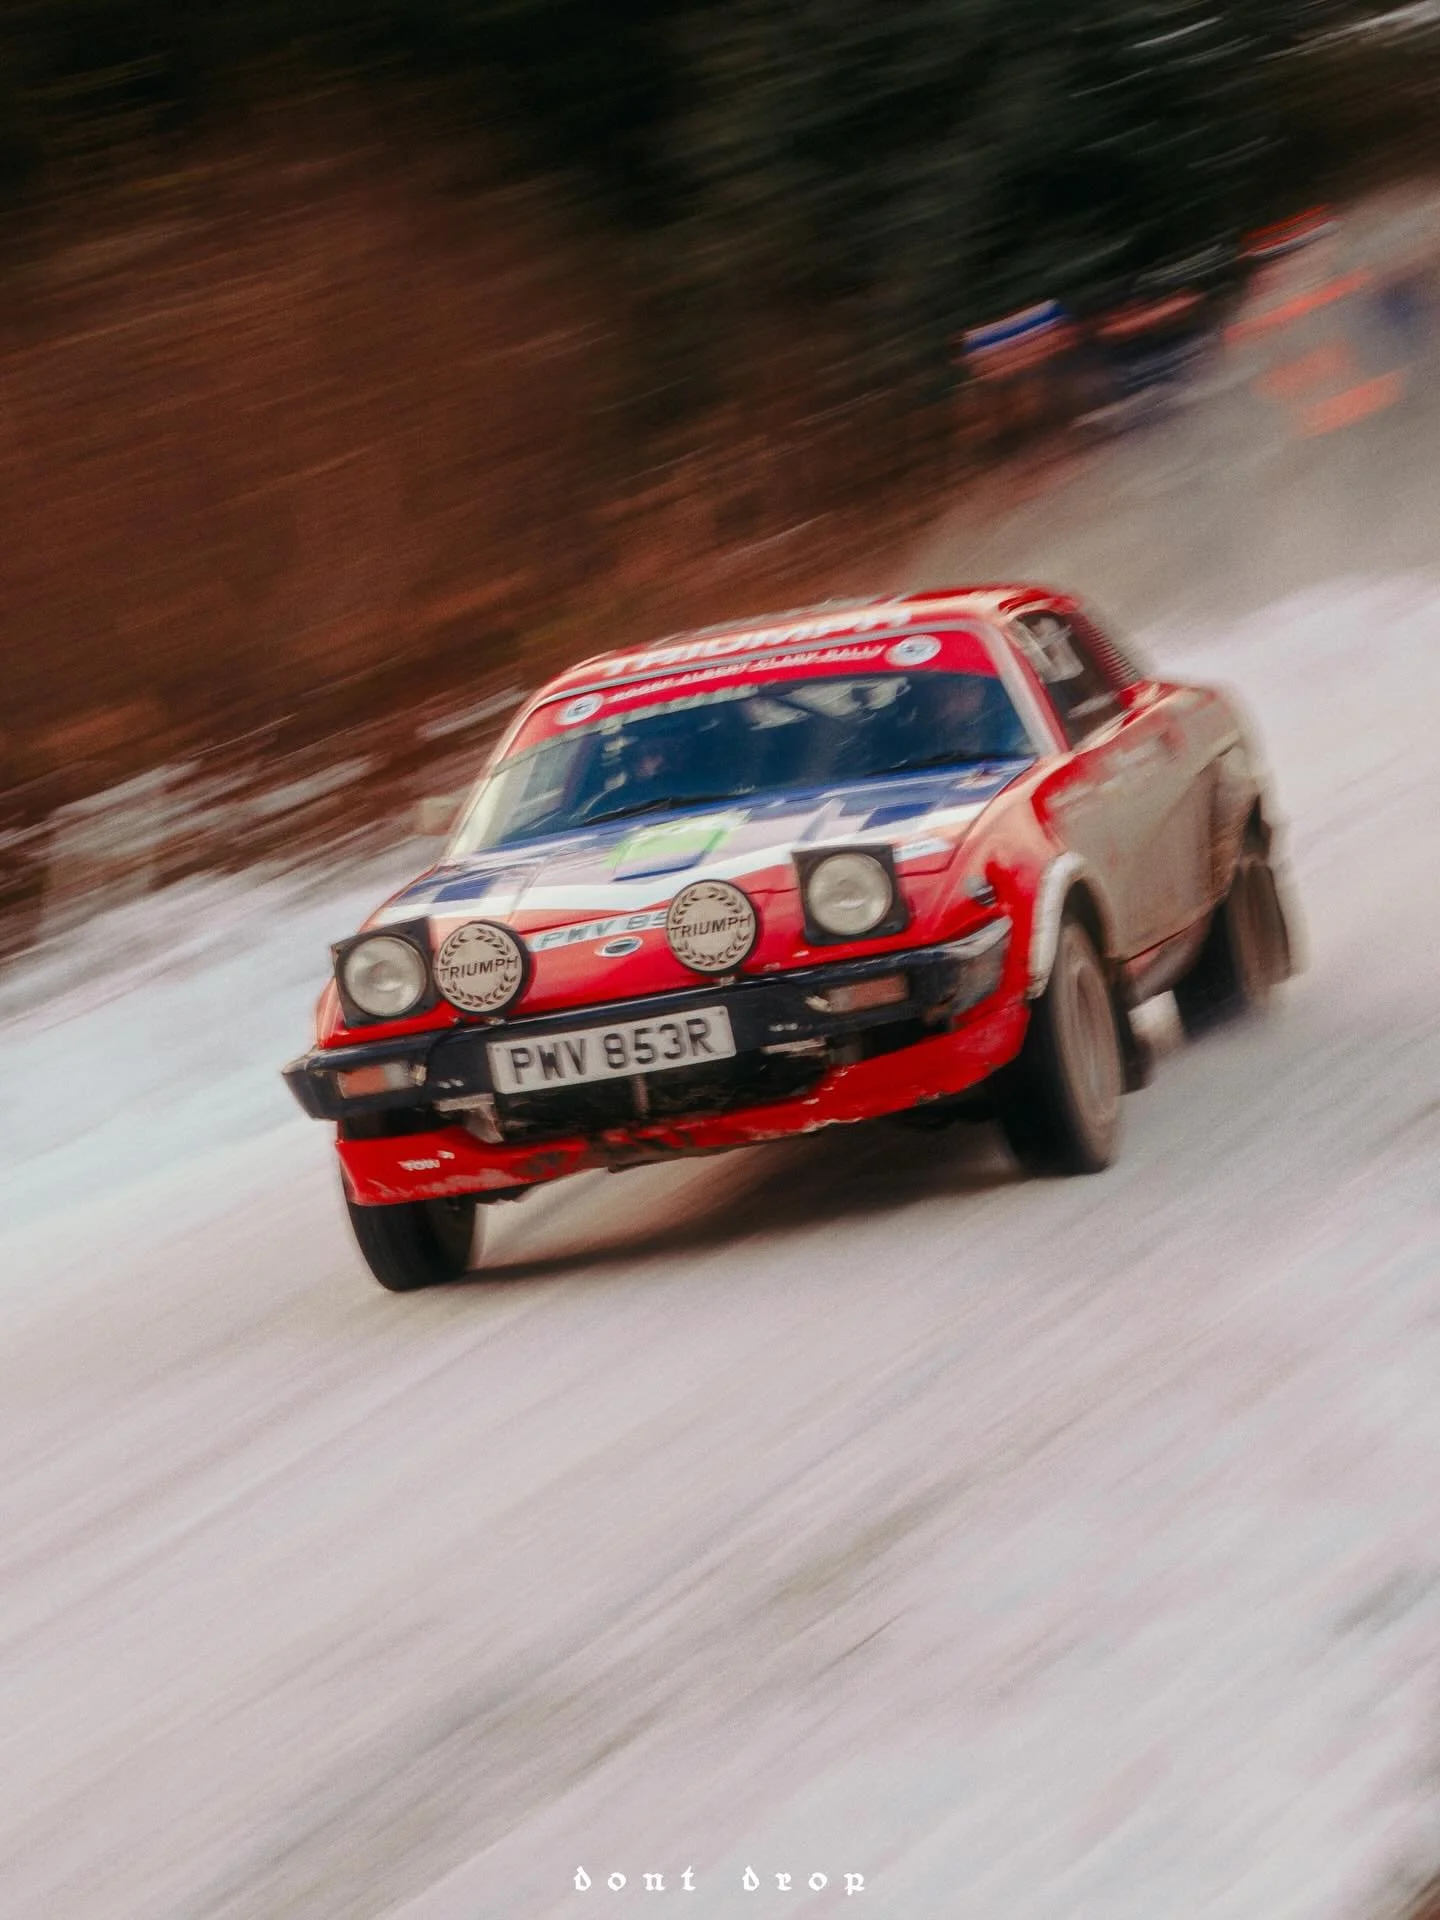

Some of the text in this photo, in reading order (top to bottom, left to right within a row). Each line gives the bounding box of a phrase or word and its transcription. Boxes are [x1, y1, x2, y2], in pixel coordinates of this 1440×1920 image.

[603, 607, 912, 677] TRIUMPH
[822, 644, 887, 661] RALLY
[669, 913, 750, 938] TRIUMPH
[438, 956, 518, 980] TRIUMPH
[509, 1017, 716, 1085] PWV 853R
